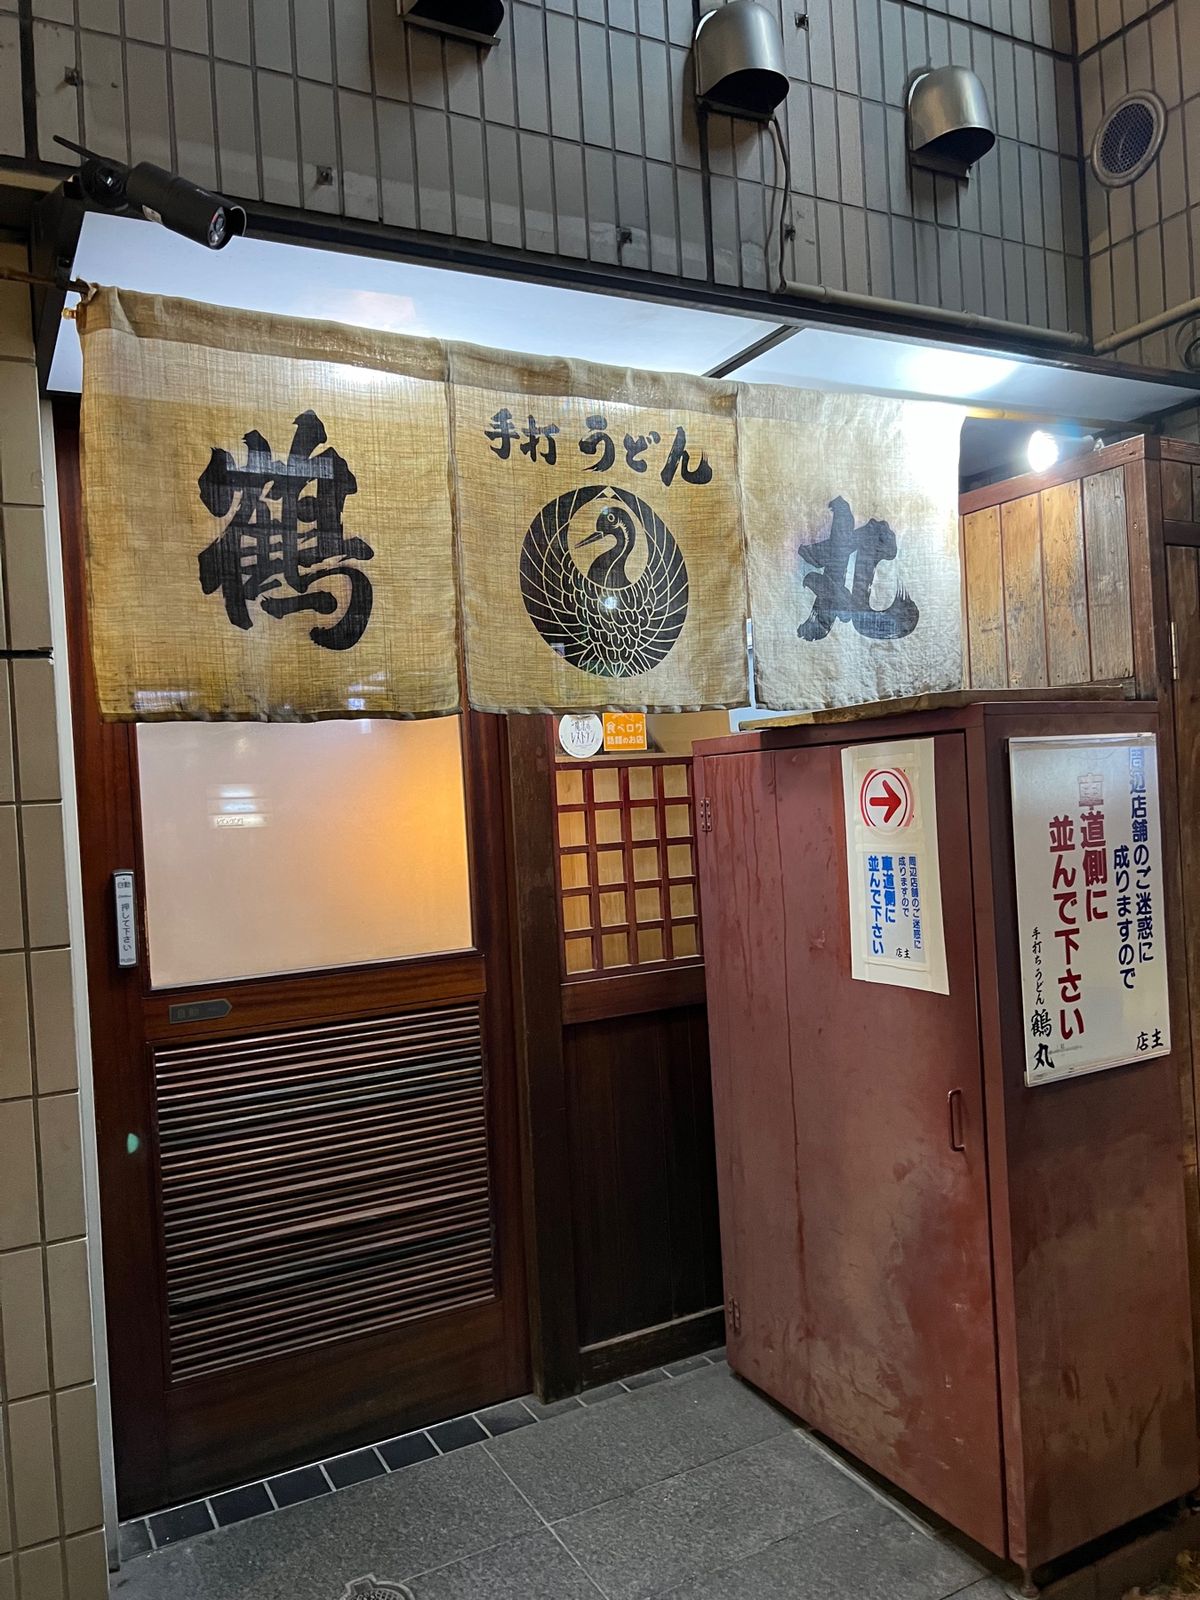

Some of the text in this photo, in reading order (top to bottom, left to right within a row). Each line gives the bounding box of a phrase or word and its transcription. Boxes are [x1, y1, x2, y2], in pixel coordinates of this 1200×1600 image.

[198, 409, 374, 650] 鶴
[797, 495, 920, 641] 丸
[606, 721, 643, 734] 食べログ
[867, 855, 884, 954] 並んで下さい
[881, 855, 896, 923] 車道側に
[898, 856, 910, 917] 成りますので
[1077, 772, 1108, 922] 車道側に
[1113, 845, 1136, 989] 成りますので
[1129, 747, 1154, 963] 周辺店舗のご迷惑に
[895, 947, 910, 959] 店主
[1031, 926, 1055, 1070] 手打ちうどん 鶴丸
[1049, 815, 1085, 1040] 並んで下さい
[1136, 1029, 1164, 1051] 店主
